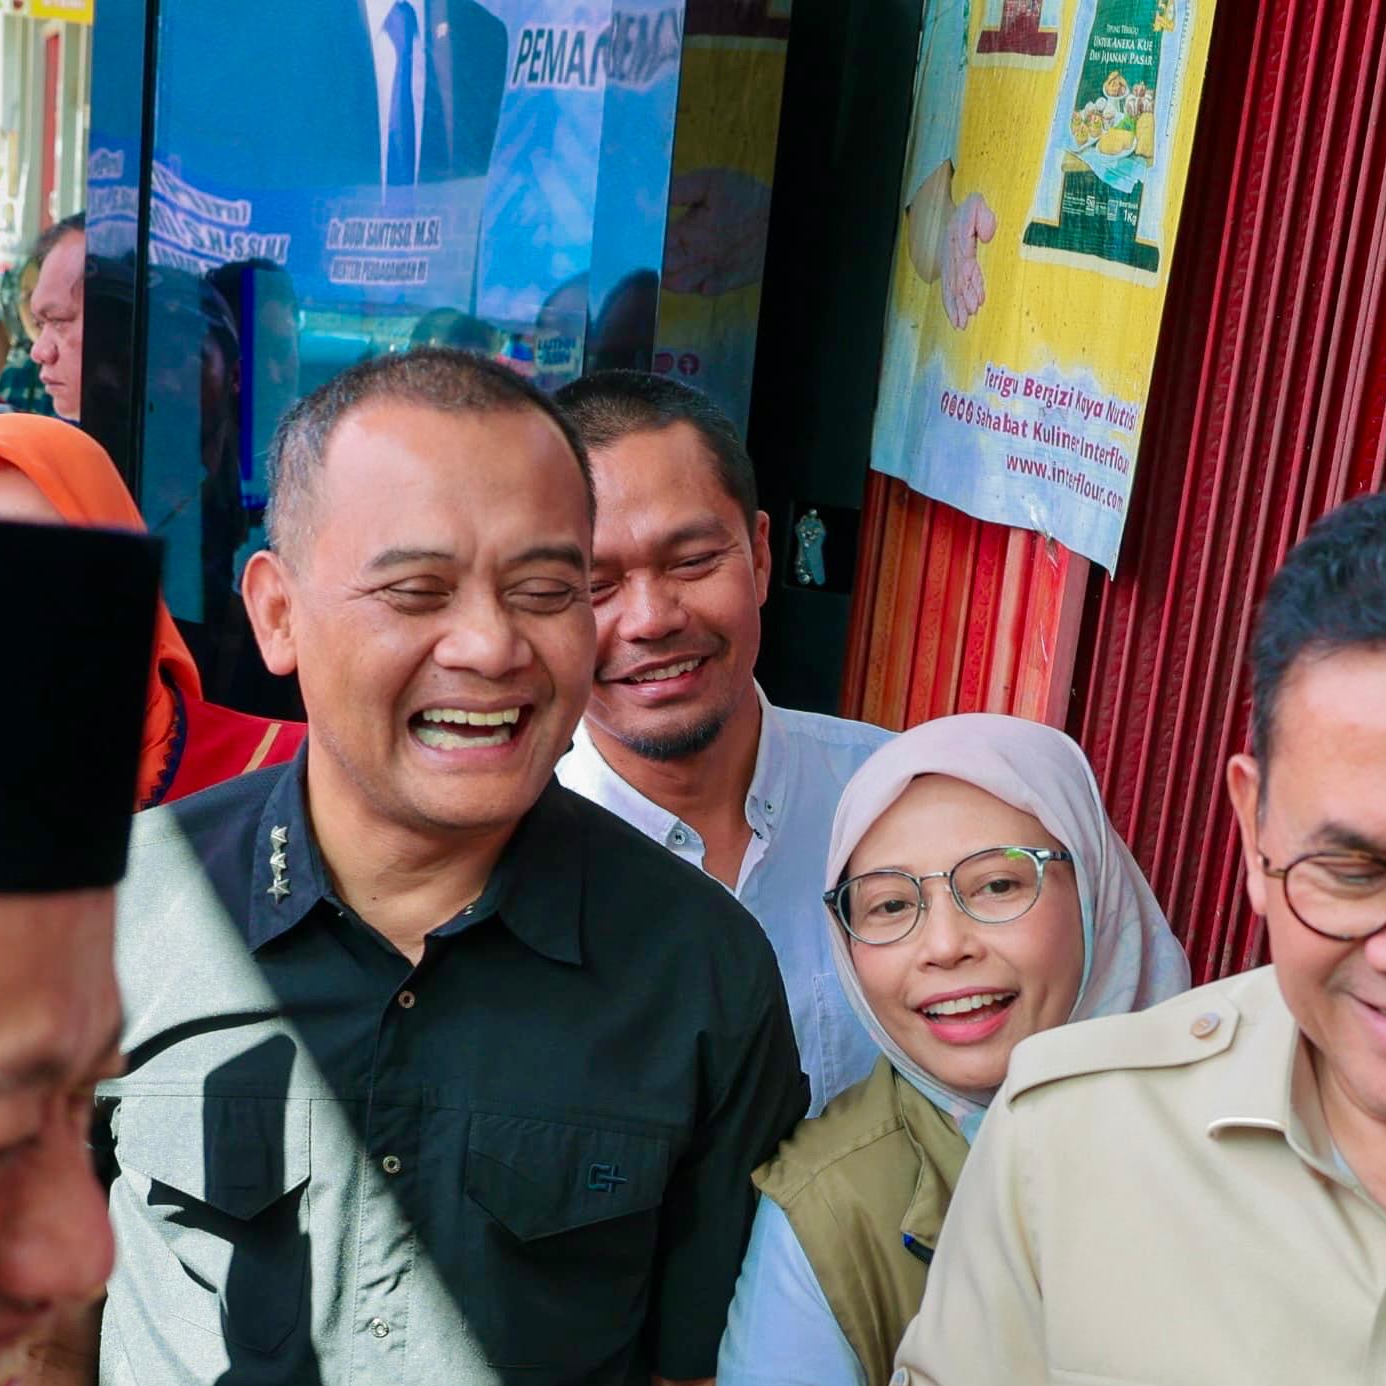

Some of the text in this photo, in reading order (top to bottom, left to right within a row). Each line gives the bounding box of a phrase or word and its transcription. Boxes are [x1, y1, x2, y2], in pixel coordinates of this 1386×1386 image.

[1093, 36, 1153, 50] UNTUK ANEKA KUE
[1101, 51, 1127, 65] JAJANAN
[1129, 52, 1153, 66] PASAR
[1123, 207, 1137, 227] 1Kg
[984, 367, 1137, 432] Terigu Bergizi Kaya Nutrisi
[975, 406, 1028, 438] Sahabat
[1032, 422, 1080, 452] Kuliner
[1005, 454, 1125, 514] www.interflour.com
